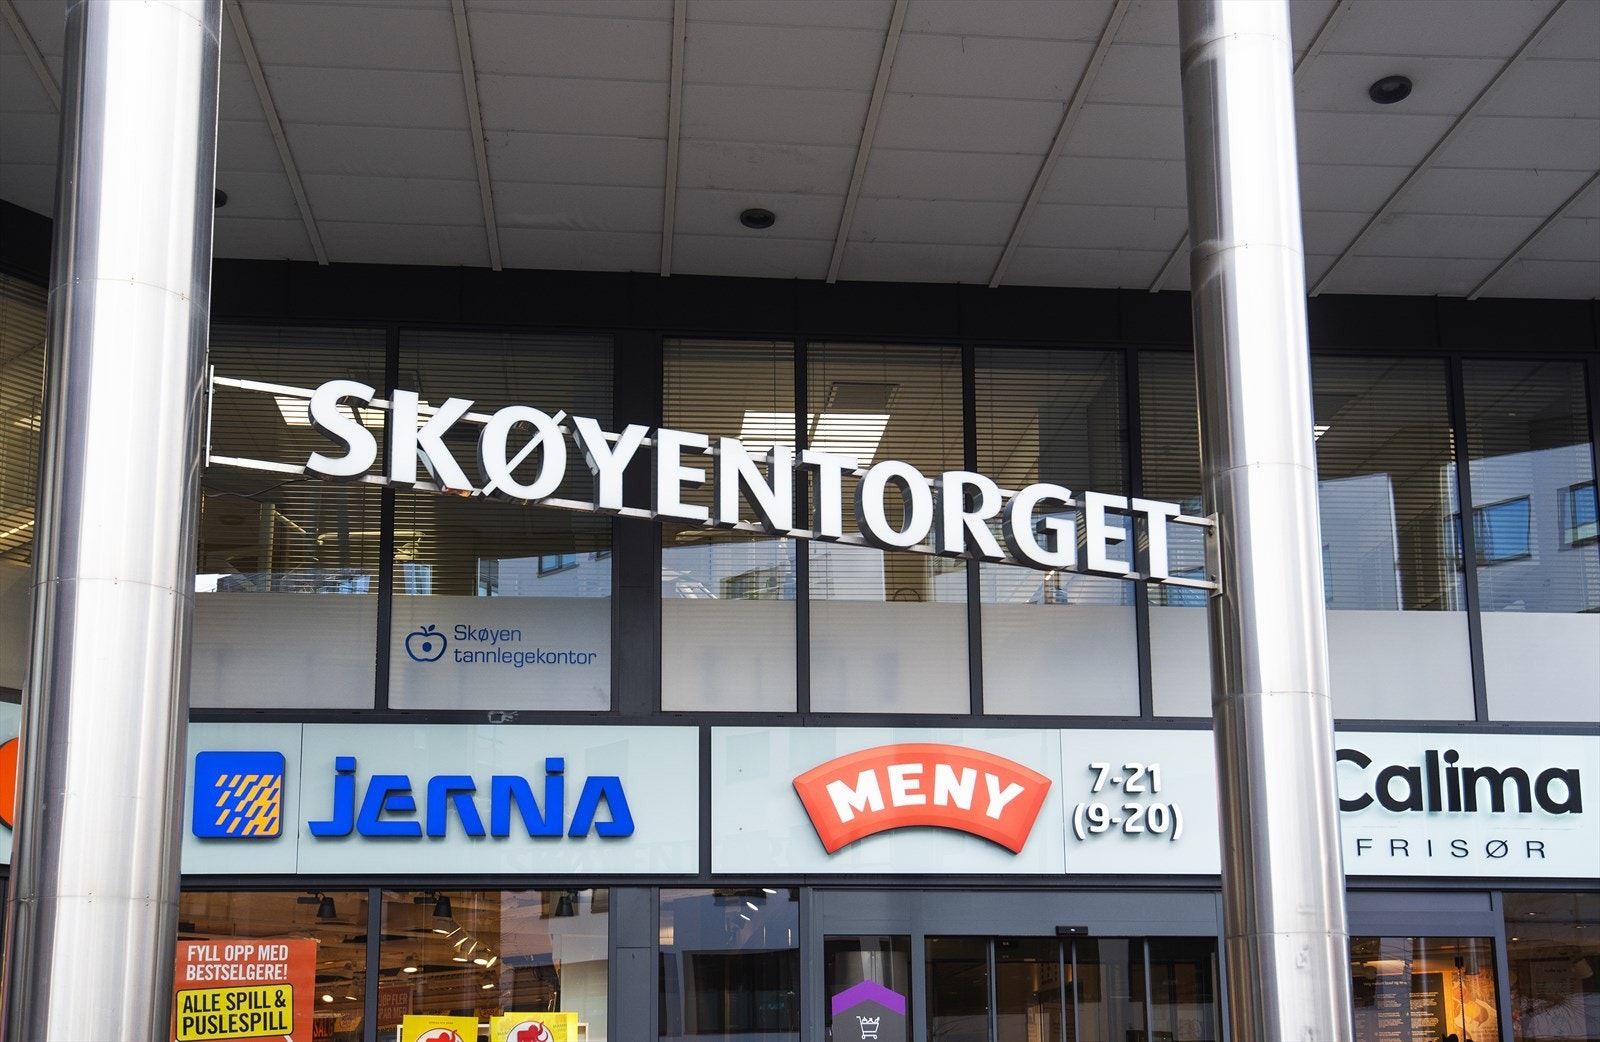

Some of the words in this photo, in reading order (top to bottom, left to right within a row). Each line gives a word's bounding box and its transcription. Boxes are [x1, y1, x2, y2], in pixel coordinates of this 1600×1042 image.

[304, 379, 1181, 582] SKØYENTORGET
[454, 624, 522, 645] Skøyen
[453, 646, 597, 667] tannlegekontor
[1089, 761, 1163, 795] 7-21
[1335, 748, 1583, 814] Calima
[825, 762, 1026, 824] MENY
[1072, 801, 1184, 841] (9-20)
[1356, 838, 1546, 859] FRISØR
[187, 945, 221, 962] FYLL
[224, 945, 254, 962] OPP
[257, 944, 289, 961] MED
[186, 963, 288, 981] BESTSELGERE!
[183, 993, 221, 1014] ALLE
[226, 990, 271, 1011] SPILL
[274, 989, 286, 1009] &
[182, 1010, 288, 1036] PUSLESPILL
